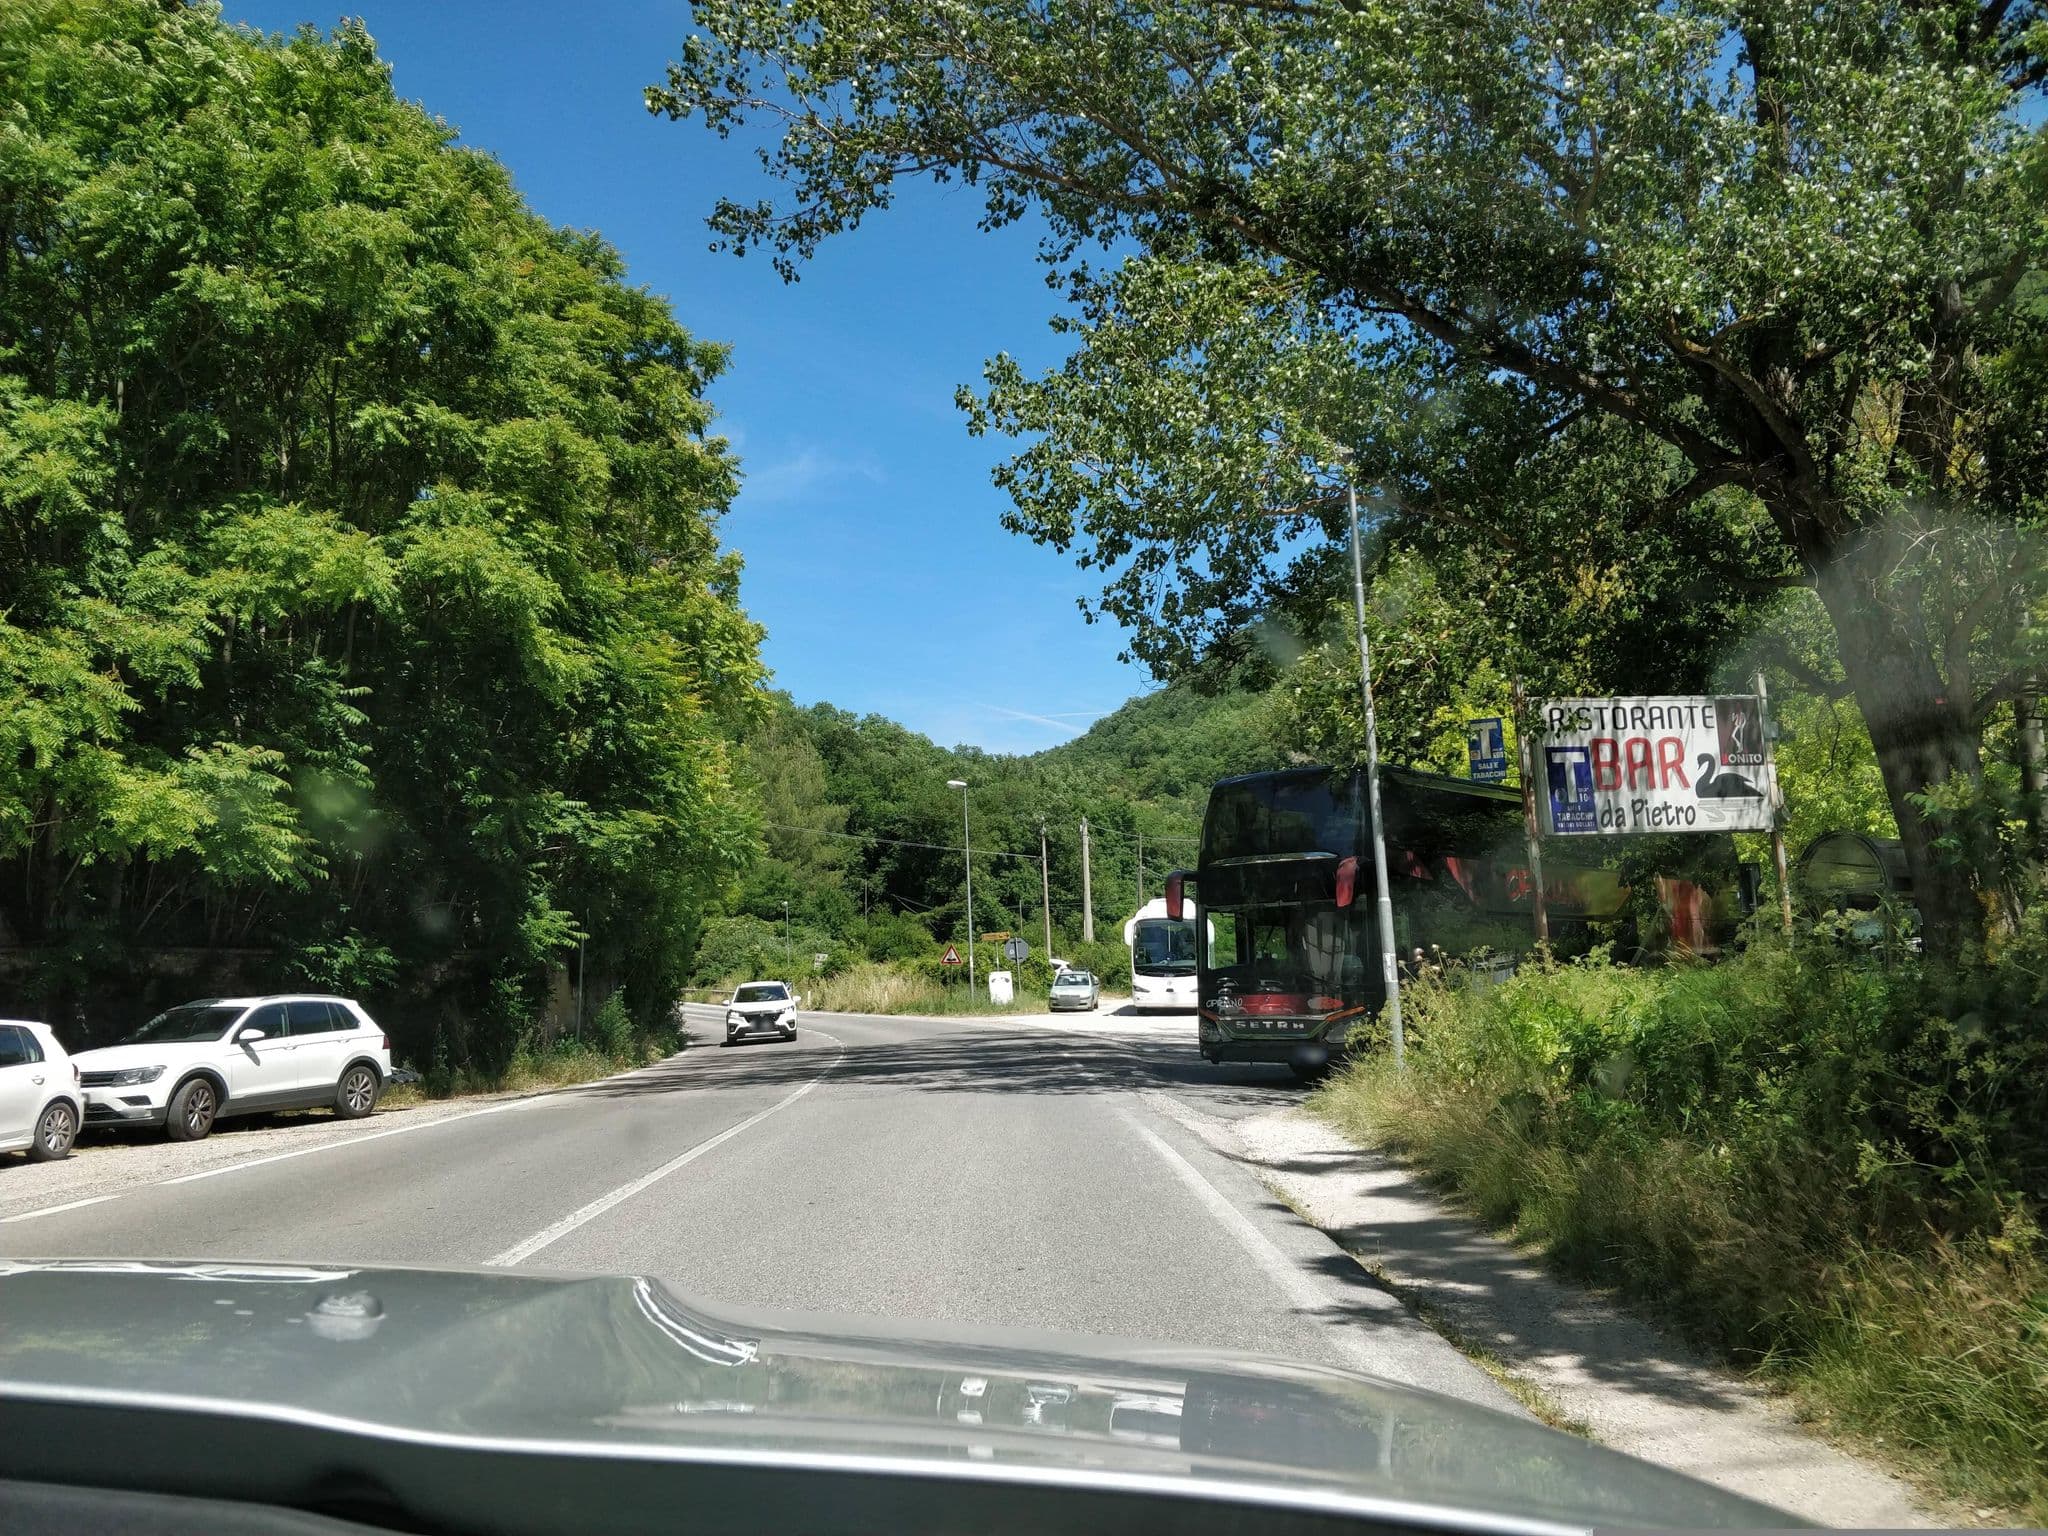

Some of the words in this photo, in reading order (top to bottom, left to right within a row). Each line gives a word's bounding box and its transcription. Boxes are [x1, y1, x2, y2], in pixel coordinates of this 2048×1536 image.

[1473, 771, 1506, 779] TABACCHI
[1551, 752, 1585, 803] T
[1591, 737, 1690, 790] BAR
[1600, 799, 1626, 828] da
[1631, 798, 1696, 827] Pietro
